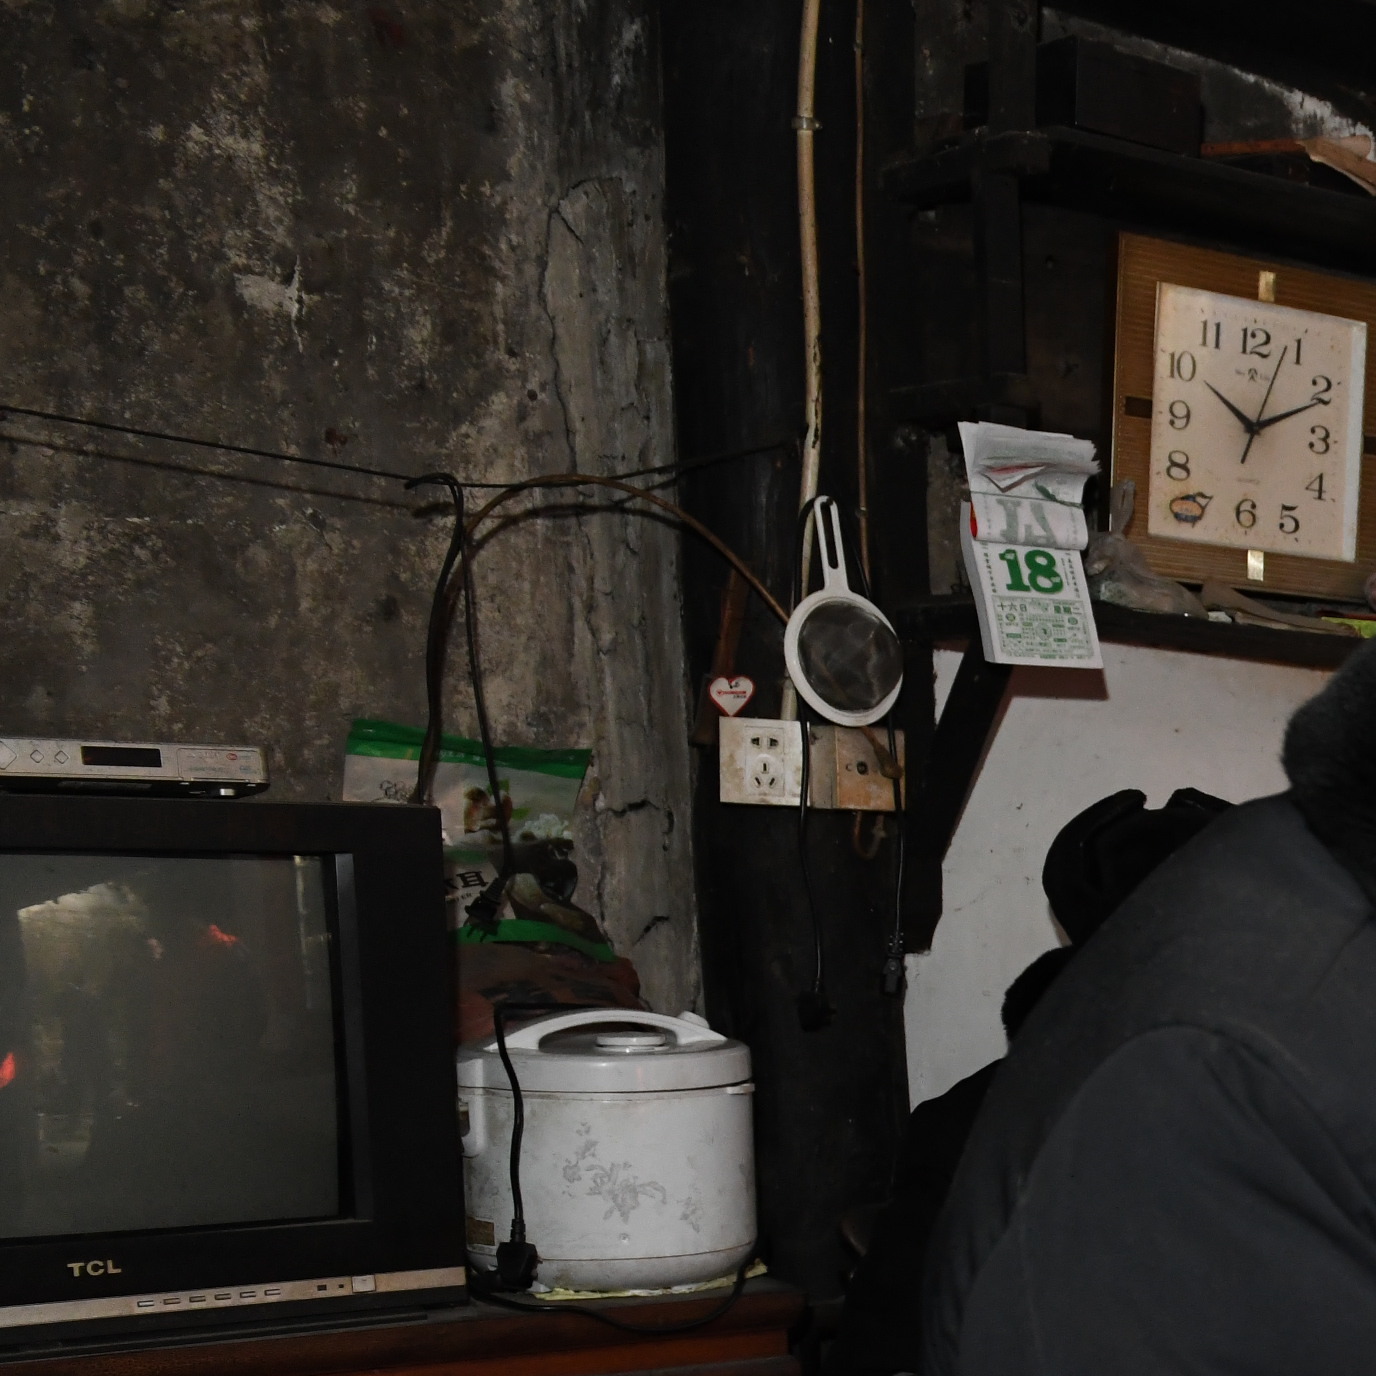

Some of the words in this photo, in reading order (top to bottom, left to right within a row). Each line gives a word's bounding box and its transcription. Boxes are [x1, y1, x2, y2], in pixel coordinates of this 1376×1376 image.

[1200, 319, 1221, 350] 11
[1241, 327, 1271, 359] 12
[1168, 351, 1197, 382] 10
[1294, 338, 1303, 366] 1
[1311, 375, 1332, 406] 2
[1168, 400, 1191, 430] 9
[1308, 425, 1331, 455] 3
[1166, 450, 1191, 481] 8
[1305, 472, 1327, 501] 4
[1235, 498, 1257, 529] 6
[1278, 503, 1300, 534] 5
[998, 549, 1064, 594] 18
[66, 1259, 122, 1278] TCL
